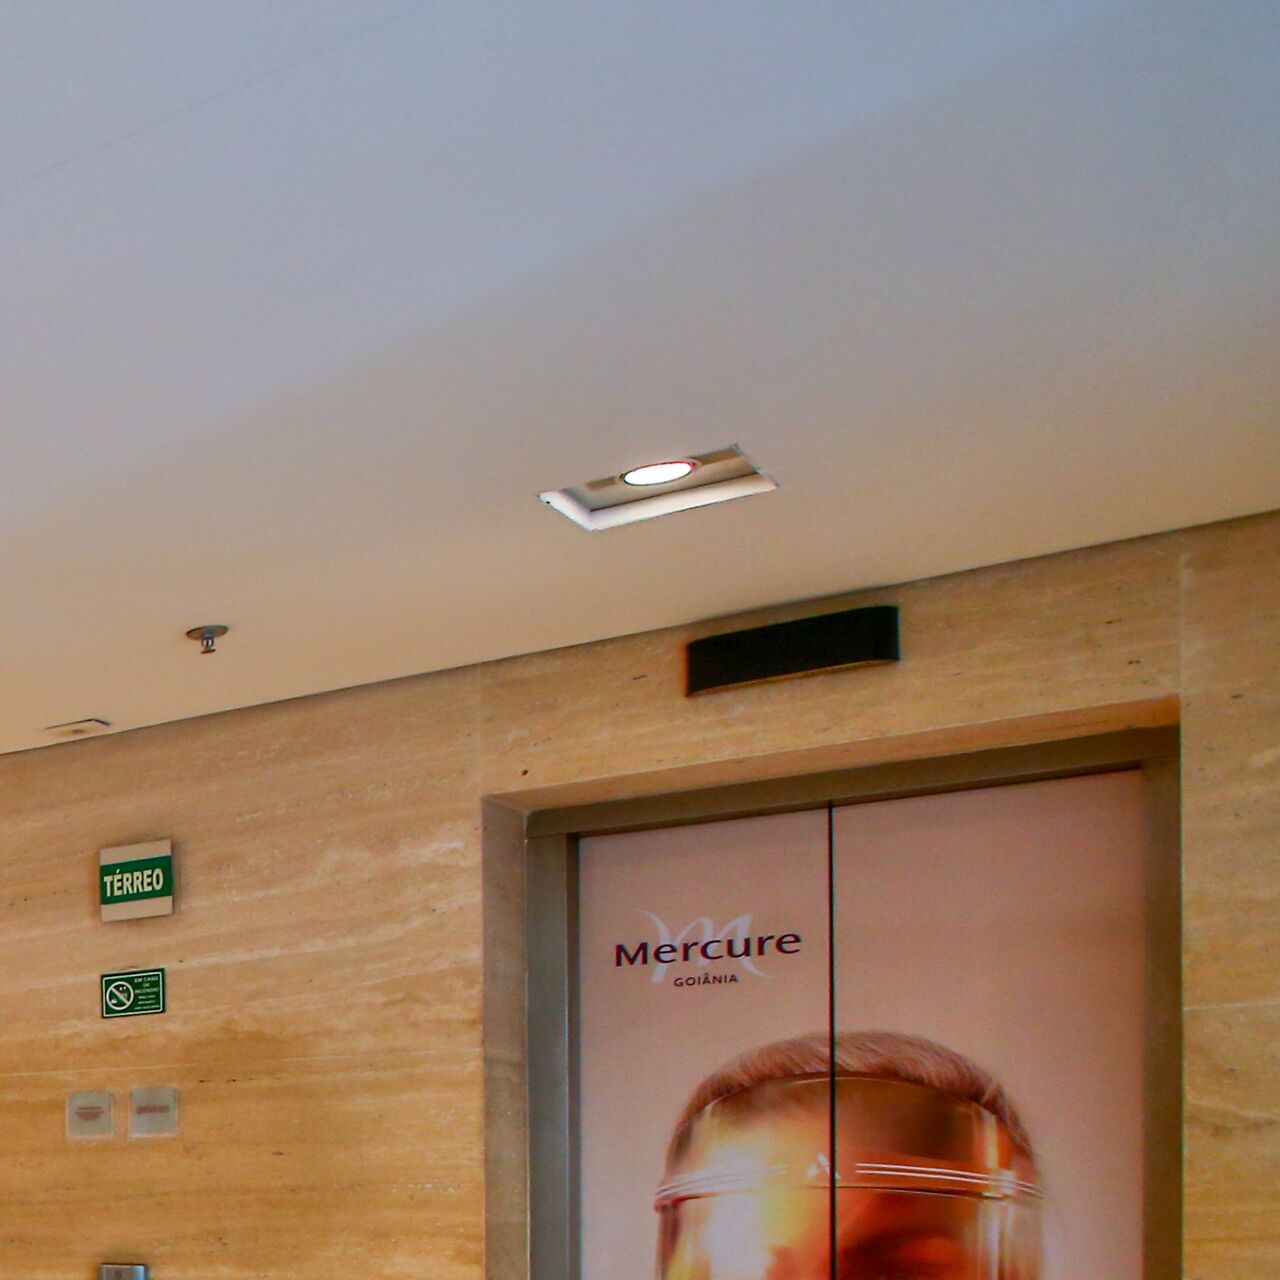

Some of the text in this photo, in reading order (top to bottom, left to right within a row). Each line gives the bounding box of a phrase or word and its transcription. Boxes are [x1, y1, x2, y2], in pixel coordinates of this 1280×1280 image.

[103, 867, 165, 897] TÉRREO
[614, 931, 803, 967] Mercure
[673, 972, 739, 987] GOIÂNIA
